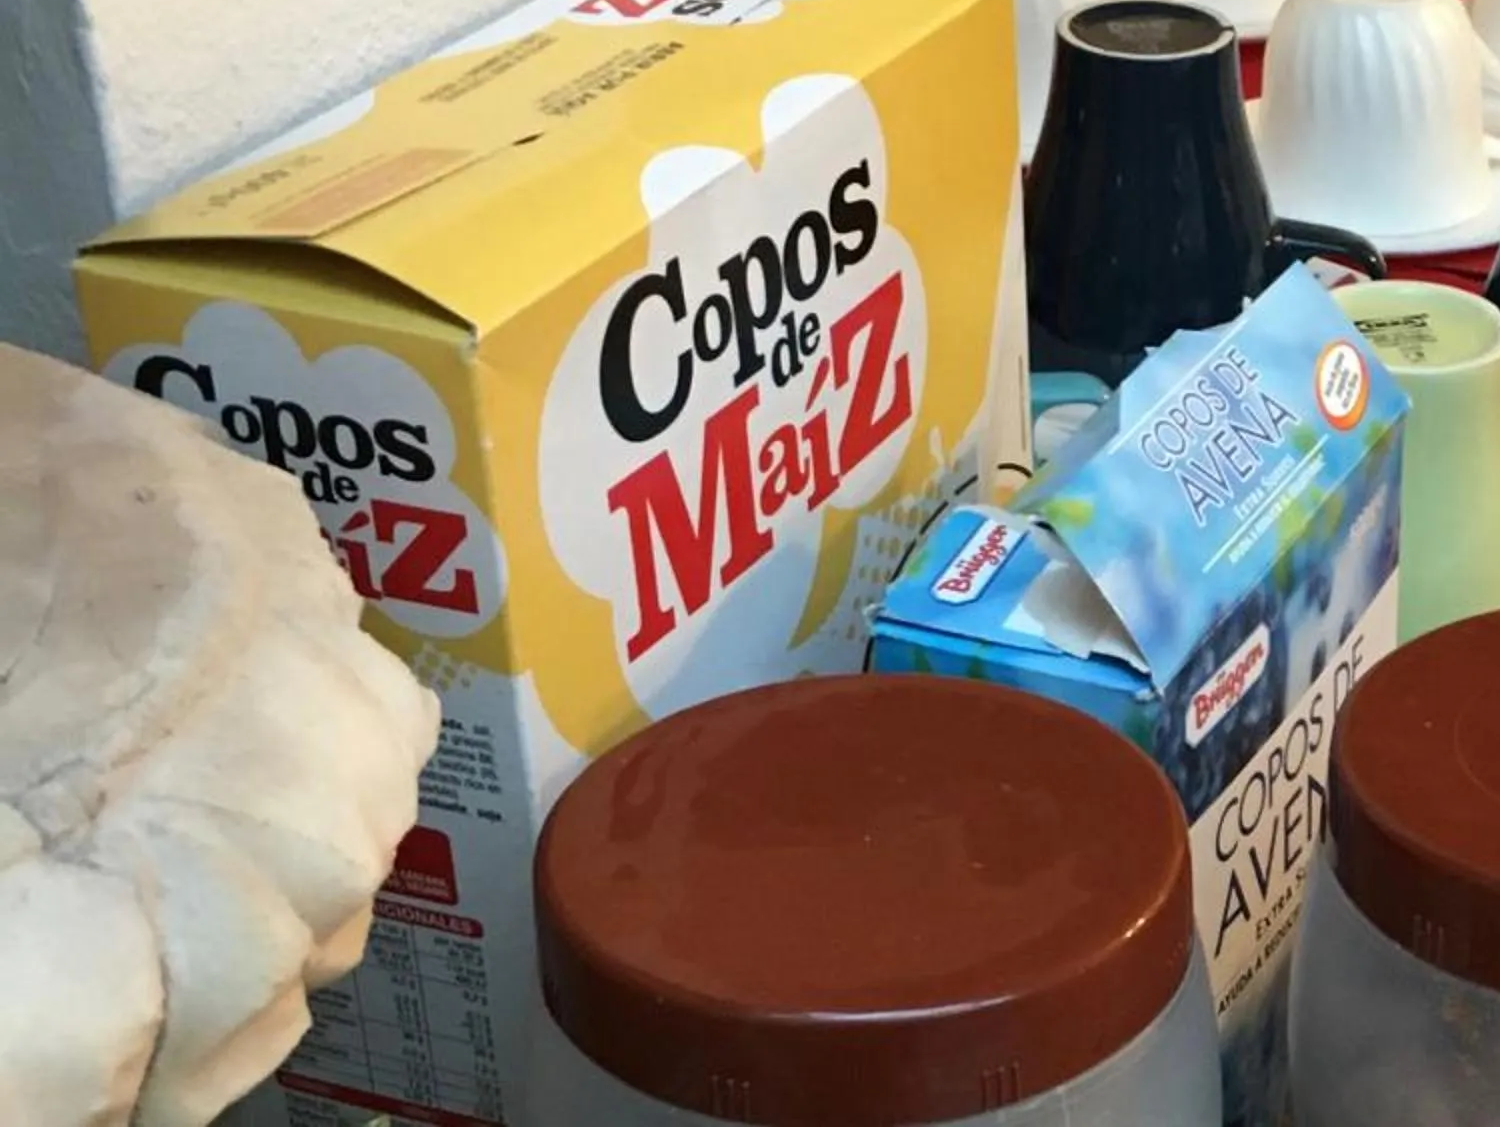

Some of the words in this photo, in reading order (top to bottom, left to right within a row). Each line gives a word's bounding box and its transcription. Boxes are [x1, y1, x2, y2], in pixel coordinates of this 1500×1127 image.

[599, 158, 879, 443] Copos
[771, 310, 821, 388] de
[1140, 378, 1228, 472] COPOS
[1212, 344, 1260, 400] DE
[1174, 391, 1301, 528] AVENA
[302, 462, 360, 505] de
[1193, 641, 1265, 730] Brüggen
[1215, 693, 1323, 863] COPOS
[1334, 635, 1364, 714] DE
[1214, 773, 1328, 960] AVEN
